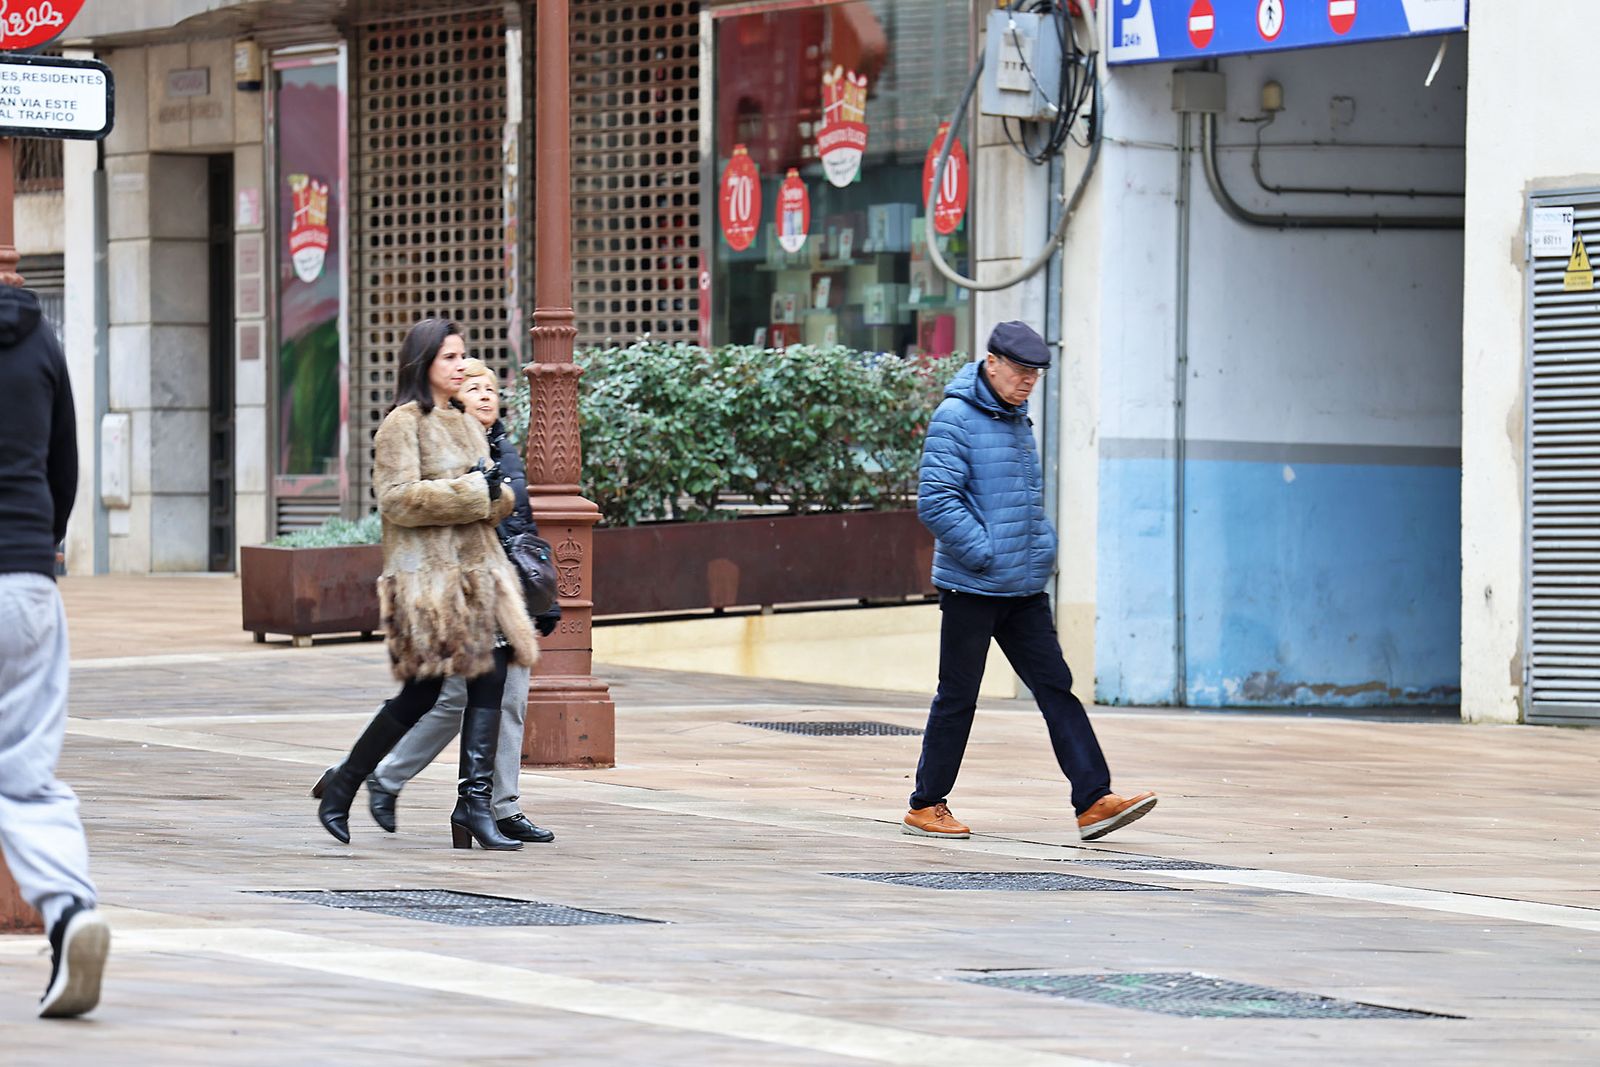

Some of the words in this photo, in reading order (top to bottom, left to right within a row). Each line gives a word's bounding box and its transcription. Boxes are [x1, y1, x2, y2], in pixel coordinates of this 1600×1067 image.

[1124, 33, 1142, 46] 24h
[20, 98, 41, 107] VIA
[45, 99, 78, 109] ESTE
[18, 110, 75, 122] TRAFICO
[1562, 212, 1572, 223] TC
